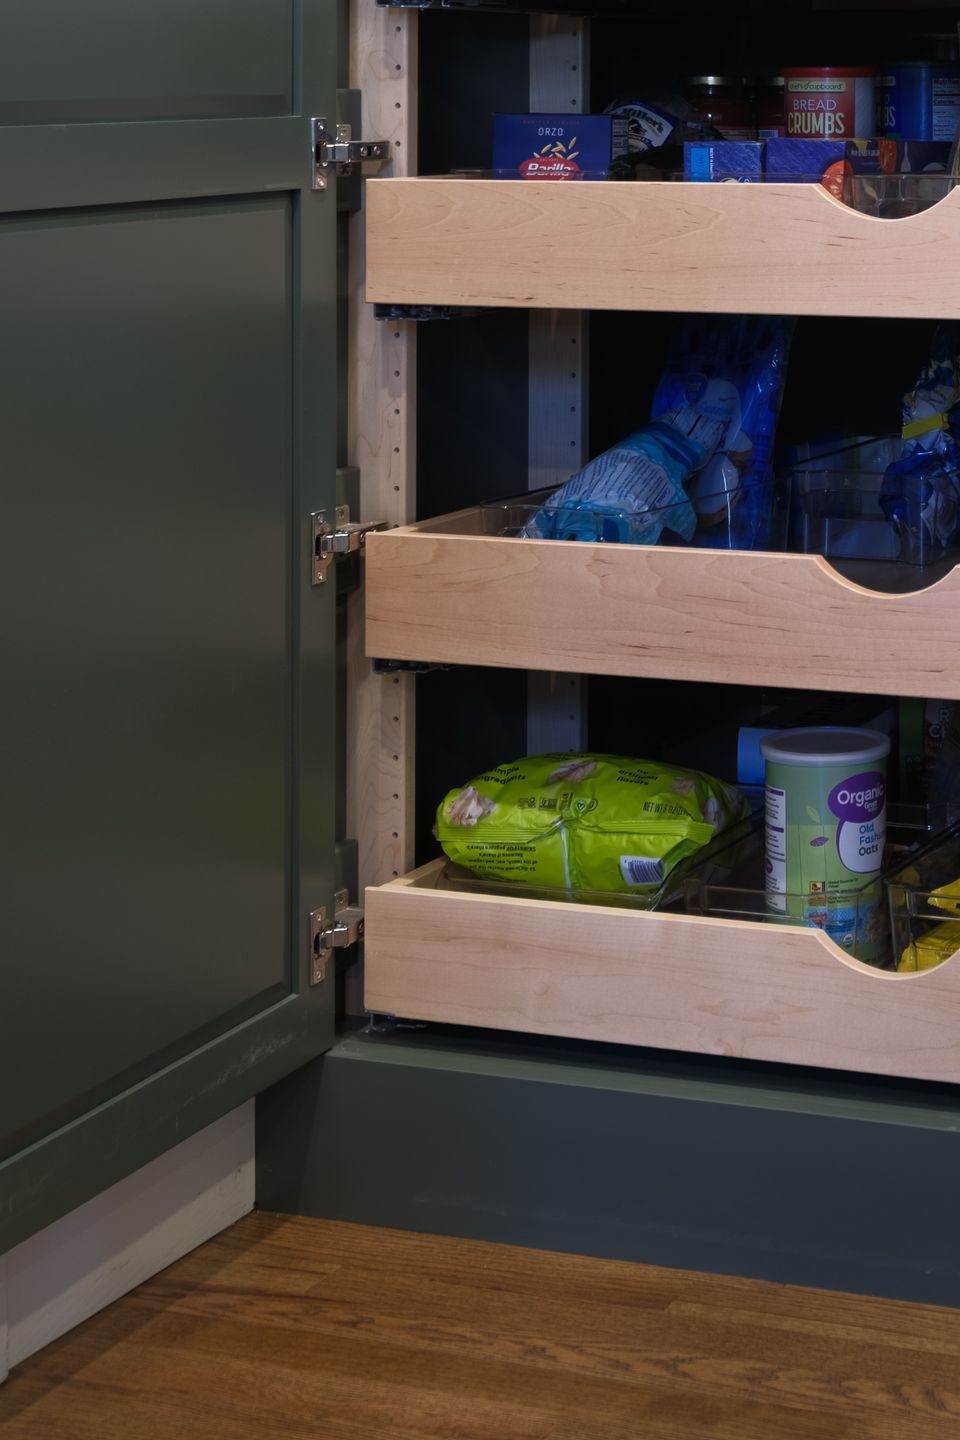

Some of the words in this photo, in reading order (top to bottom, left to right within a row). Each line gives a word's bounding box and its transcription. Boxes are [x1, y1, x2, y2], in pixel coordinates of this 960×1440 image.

[792, 98, 837, 111] BREAD
[787, 111, 846, 135] CRUMBS
[537, 127, 564, 137] ORZO
[837, 783, 884, 808] Organic
[859, 824, 875, 835] Old
[858, 845, 879, 857] Oats
